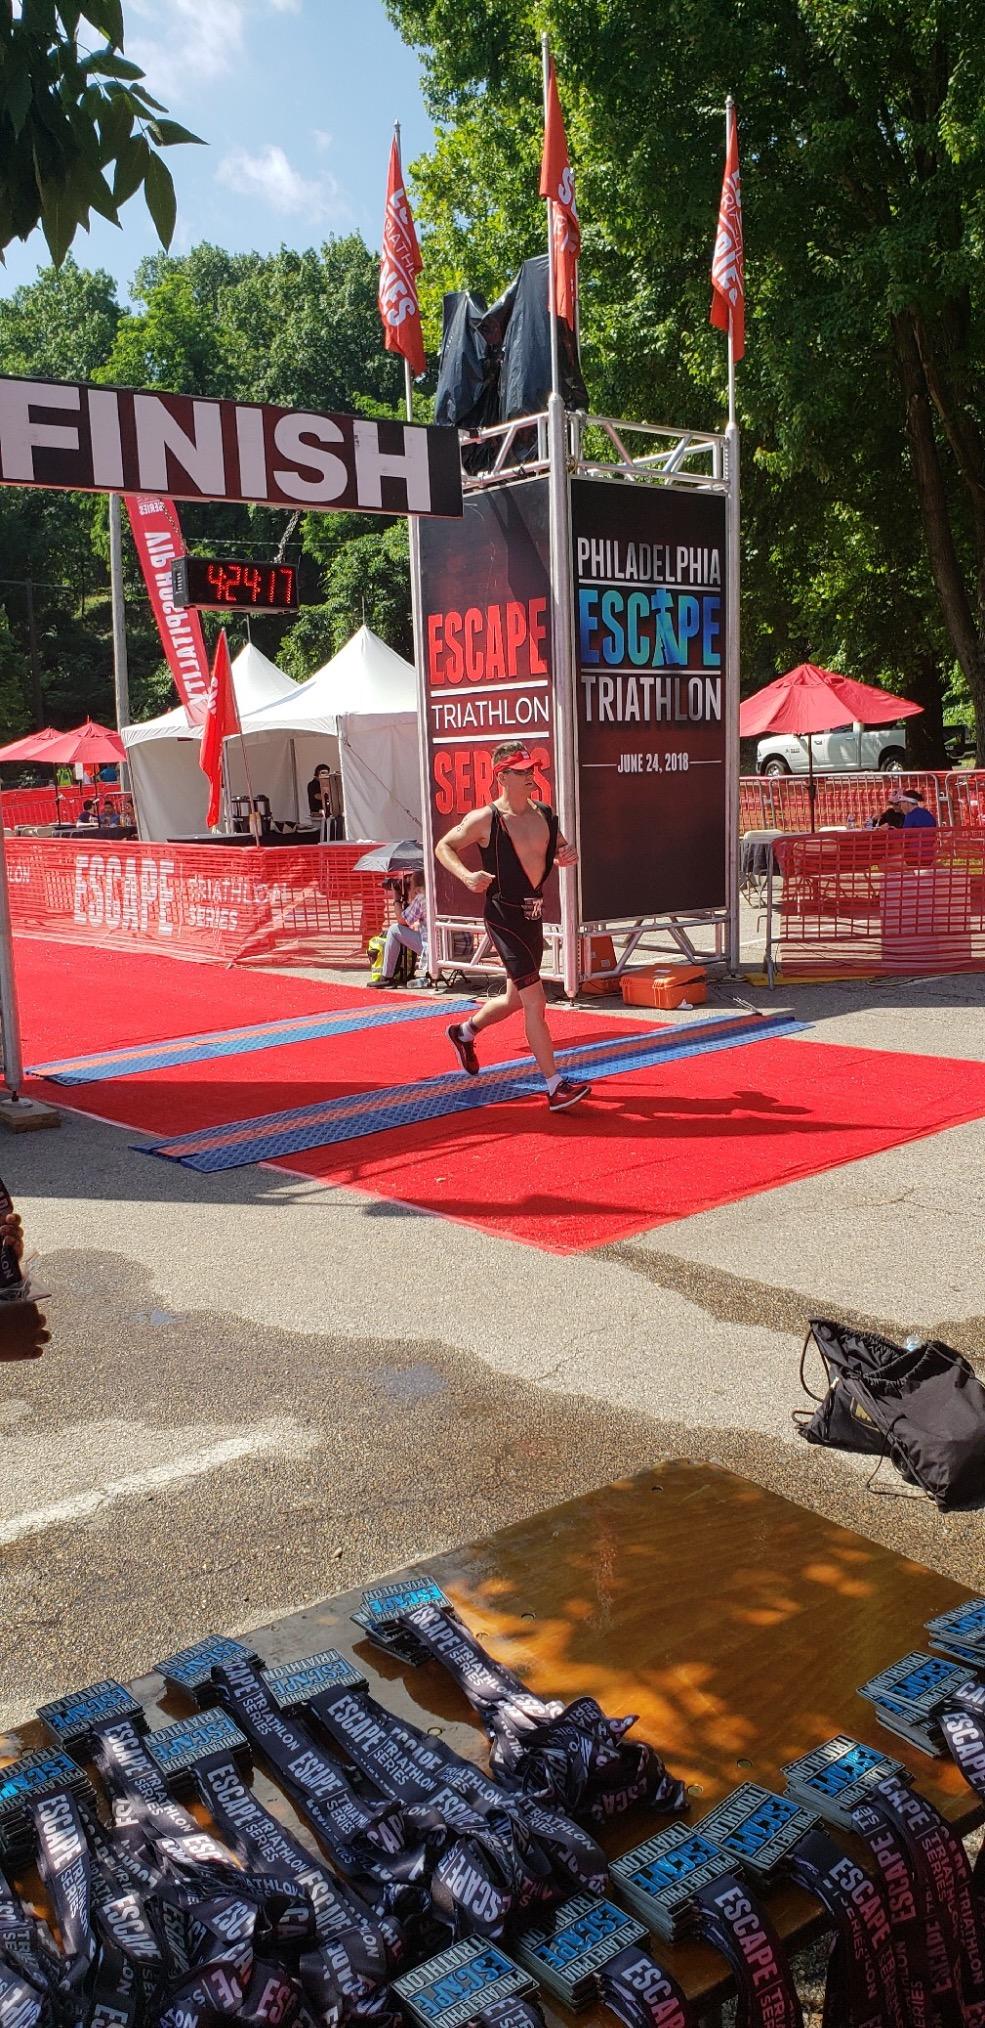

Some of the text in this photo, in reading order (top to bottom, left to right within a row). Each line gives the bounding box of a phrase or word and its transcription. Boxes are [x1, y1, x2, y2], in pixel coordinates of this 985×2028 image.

[0, 379, 432, 513] FINISH
[577, 536, 721, 585] PHILADELPHIA
[427, 597, 547, 686] ESCAPE
[578, 588, 721, 668] ESCAPE
[431, 695, 549, 731] TRIATHLON
[580, 675, 722, 722] TRIATHLON
[433, 746, 551, 816] SERS
[617, 752, 690, 775] JUNE 24, 2018
[73, 854, 175, 937] ESCAPE
[187, 905, 239, 931] SERIES
[408, 1605, 461, 1652] ESCAPE
[263, 1651, 337, 1681] TRIATHLON
[271, 1659, 350, 1695] ESCAPE
[449, 1649, 484, 1687] SERIES
[143, 1709, 222, 1747] TRIATHLON
[150, 1719, 235, 1762] ESCAPE
[242, 1698, 273, 1736] SERIES
[253, 1691, 300, 1751] TRIATHLON
[328, 1694, 386, 1753] ESCAPE
[104, 1721, 152, 1777] ESCAPE
[287, 1750, 344, 1797] ESCAPE
[373, 1749, 410, 1786] SERIES
[383, 1740, 438, 1792] TRIATHLON
[788, 1736, 854, 1781] TRIATHLON
[804, 1743, 886, 1797] ESCAPE
[134, 1778, 164, 1816] SERIES
[145, 1771, 195, 1833] TRIATHLON
[206, 1764, 260, 1827] ESCAPE
[326, 1800, 355, 1835] SERIES
[702, 1786, 768, 1842] TRIATHLON
[879, 1776, 931, 1832] CAPE
[37, 1794, 83, 1870] ESCAPE
[246, 1823, 280, 1863] SERIES
[257, 1818, 310, 1872] TRIATHLON
[522, 1798, 597, 1852] TRIATHLON
[611, 1824, 691, 1876] TRIATHLON
[721, 1794, 800, 1856] ESCAPE
[754, 1808, 819, 1866] PHILADELPHIA
[627, 1833, 720, 1895] ESCAPE
[655, 1851, 736, 1907] PHILADELPHIA
[870, 1832, 918, 1924] ESCAPE
[922, 1840, 949, 1901] SERIES
[59, 1870, 81, 1920] SERIES
[297, 1870, 351, 1938] ESCAPE
[828, 1856, 891, 1950] ESCAPE
[102, 1895, 164, 1962] ESCAPE
[535, 1902, 630, 1969] ESCAPE
[560, 1920, 645, 1982] PHILADELPHIA
[713, 1886, 779, 1987] ESCAPE
[958, 1886, 985, 1985] TRIATHLON
[393, 1937, 489, 1997] TRIATHLON
[412, 1949, 514, 2018] ESCAPE
[432, 1969, 530, 2028] PHILADELPHIA
